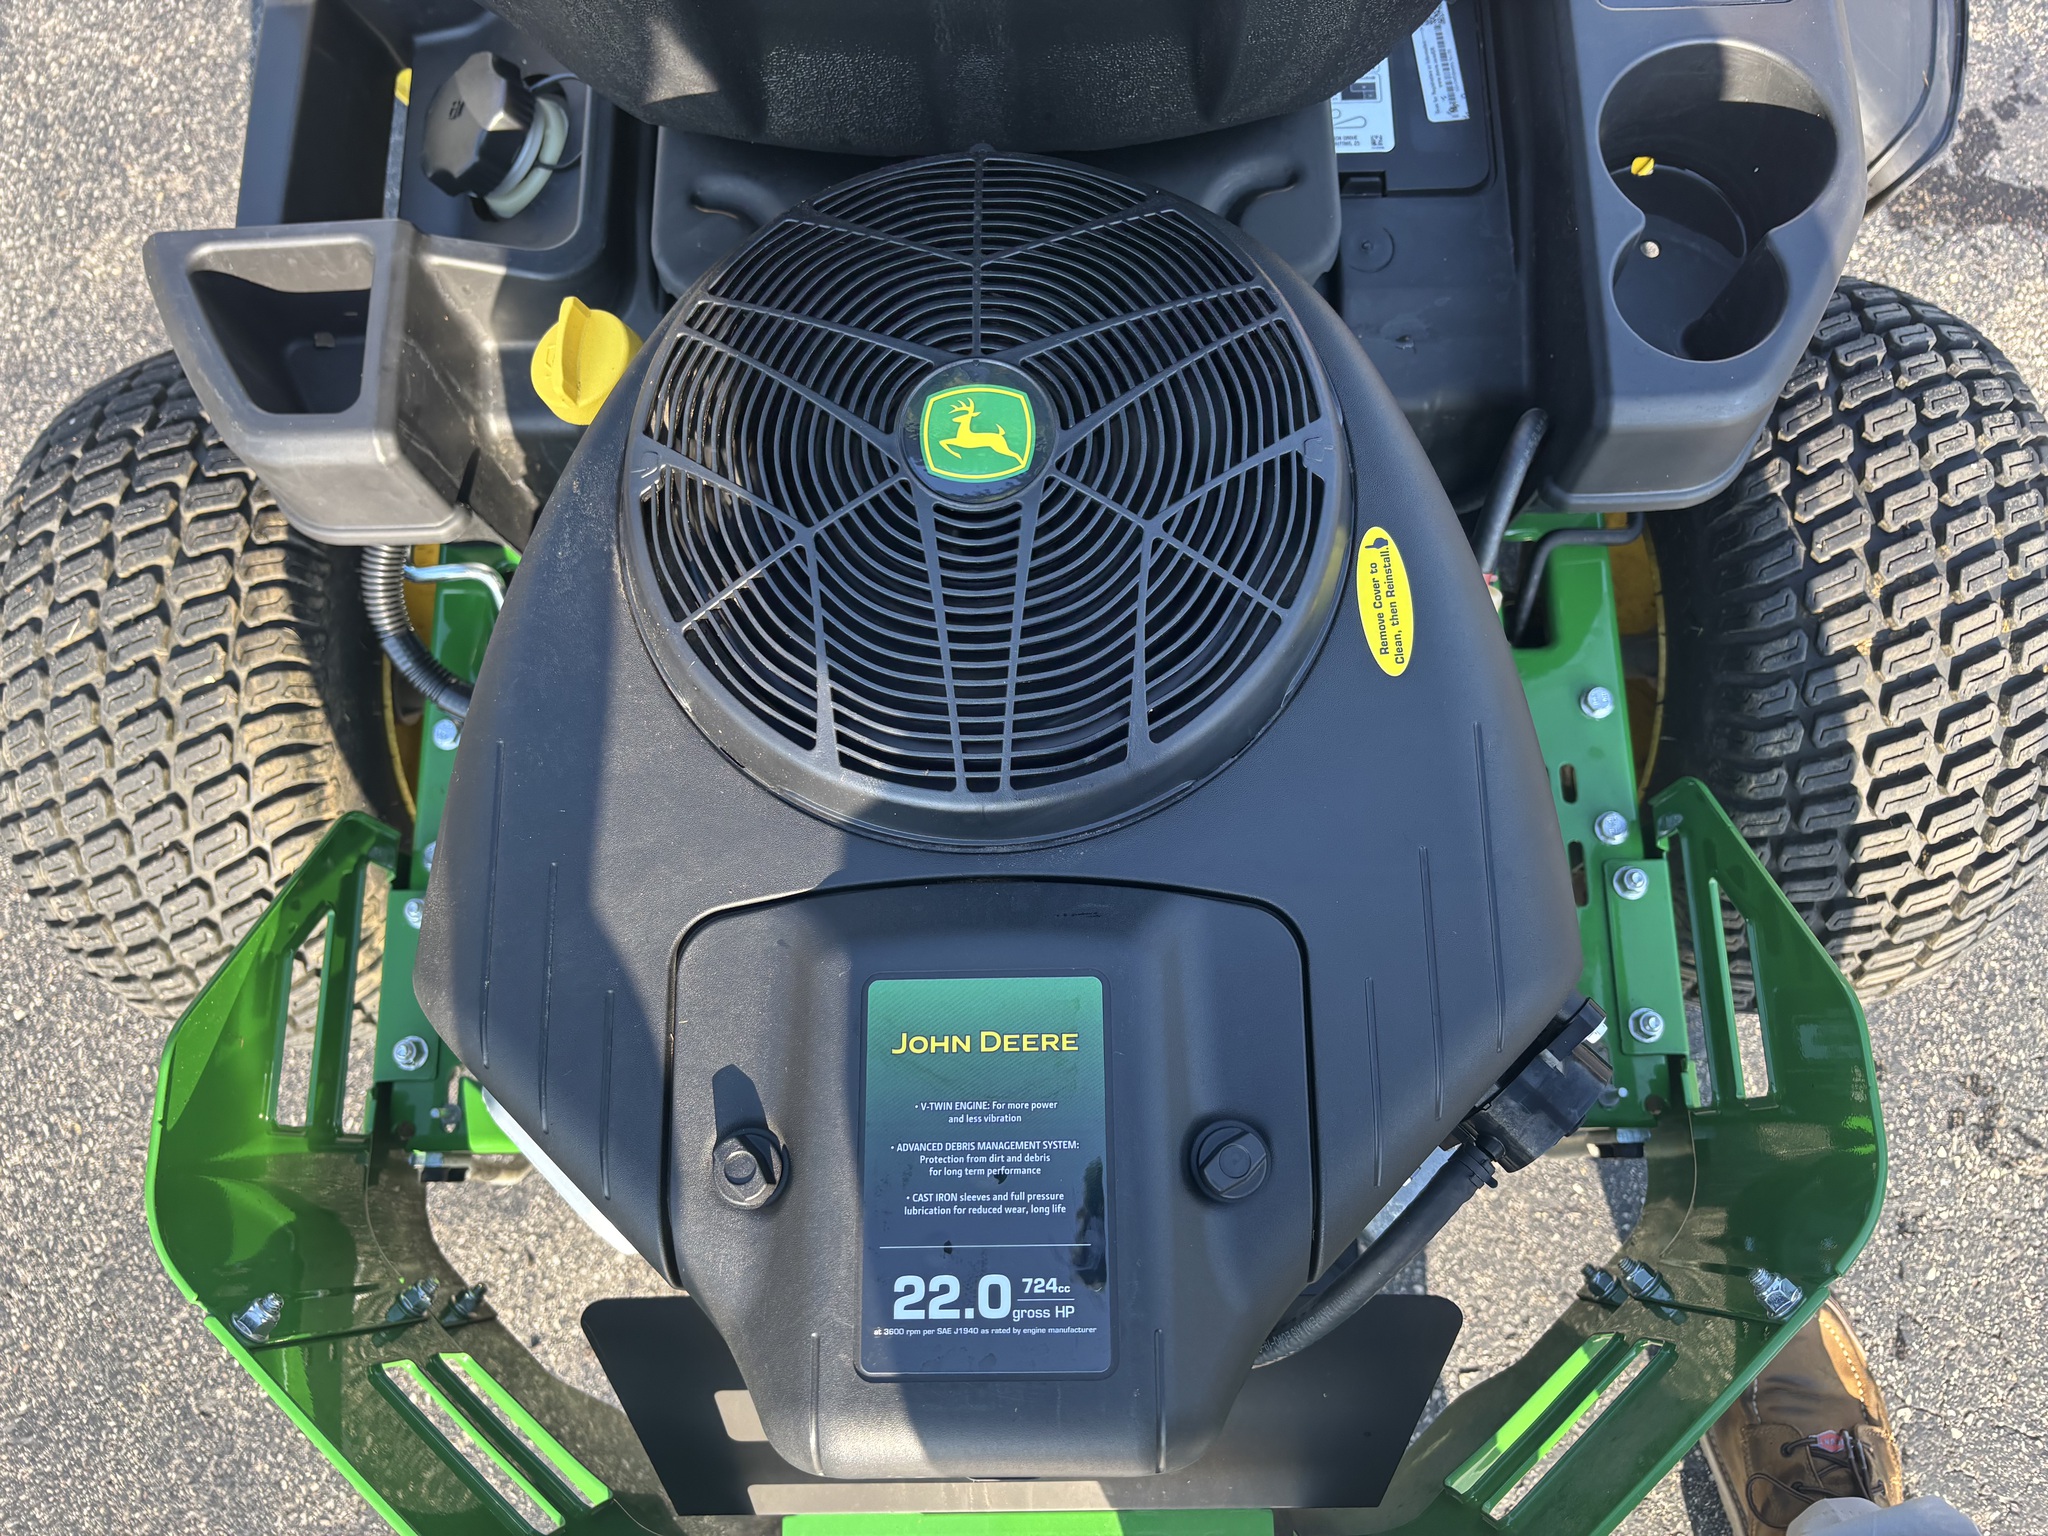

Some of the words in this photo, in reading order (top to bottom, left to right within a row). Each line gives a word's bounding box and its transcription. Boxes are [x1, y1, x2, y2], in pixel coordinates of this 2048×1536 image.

[1370, 562, 1378, 574] to
[1380, 547, 1395, 598] Reinstall.
[1373, 578, 1382, 609] Cover
[1389, 601, 1399, 626] then
[1377, 612, 1389, 655] Remove
[1394, 630, 1405, 664] Clean,
[891, 1032, 971, 1055] JOHN
[979, 1030, 1079, 1053] DEERE
[921, 1102, 952, 1111] V-TWIN
[954, 1101, 990, 1111] ENGINE:
[992, 1101, 1005, 1110] For
[1031, 1102, 1058, 1111] power
[948, 1114, 964, 1123] and
[966, 1114, 982, 1123] less
[984, 1114, 1022, 1123] vibration
[897, 1143, 944, 1152] ADVANCED
[945, 1142, 976, 1151] DEBRIS
[977, 1141, 1041, 1150] MANAGEMENT
[1042, 1140, 1080, 1150] SYSTEM:
[919, 1155, 965, 1164] Protection
[966, 1154, 987, 1163] from
[989, 1154, 1005, 1163] dirt
[1006, 1154, 1022, 1163] and
[1024, 1153, 1051, 1162] debris
[929, 1167, 942, 1176] for
[943, 1167, 962, 1178] long
[987, 1166, 1041, 1177] performance
[912, 1193, 934, 1202] CAST
[935, 1193, 958, 1202] IRON
[959, 1192, 990, 1201] sleeves
[992, 1192, 1008, 1201] and
[1010, 1192, 1025, 1201] full
[1027, 1192, 1064, 1202] pressure
[904, 1206, 952, 1215] lubrication
[953, 1206, 967, 1214] for
[968, 1205, 1003, 1214] reduced
[1004, 1207, 1029, 1215] wear,
[1031, 1205, 1050, 1215] long
[1051, 1205, 1066, 1213] life
[1021, 1278, 1071, 1294] 724cc
[893, 1274, 1012, 1320] 22.0
[1012, 1308, 1051, 1322] gross
[1055, 1305, 1075, 1318] HP
[873, 1328, 882, 1336] at
[883, 1327, 904, 1335] 3600
[922, 1328, 935, 1336] per
[953, 1327, 979, 1335] J1940
[1012, 1327, 1021, 1335] by
[1023, 1327, 1046, 1335] engine
